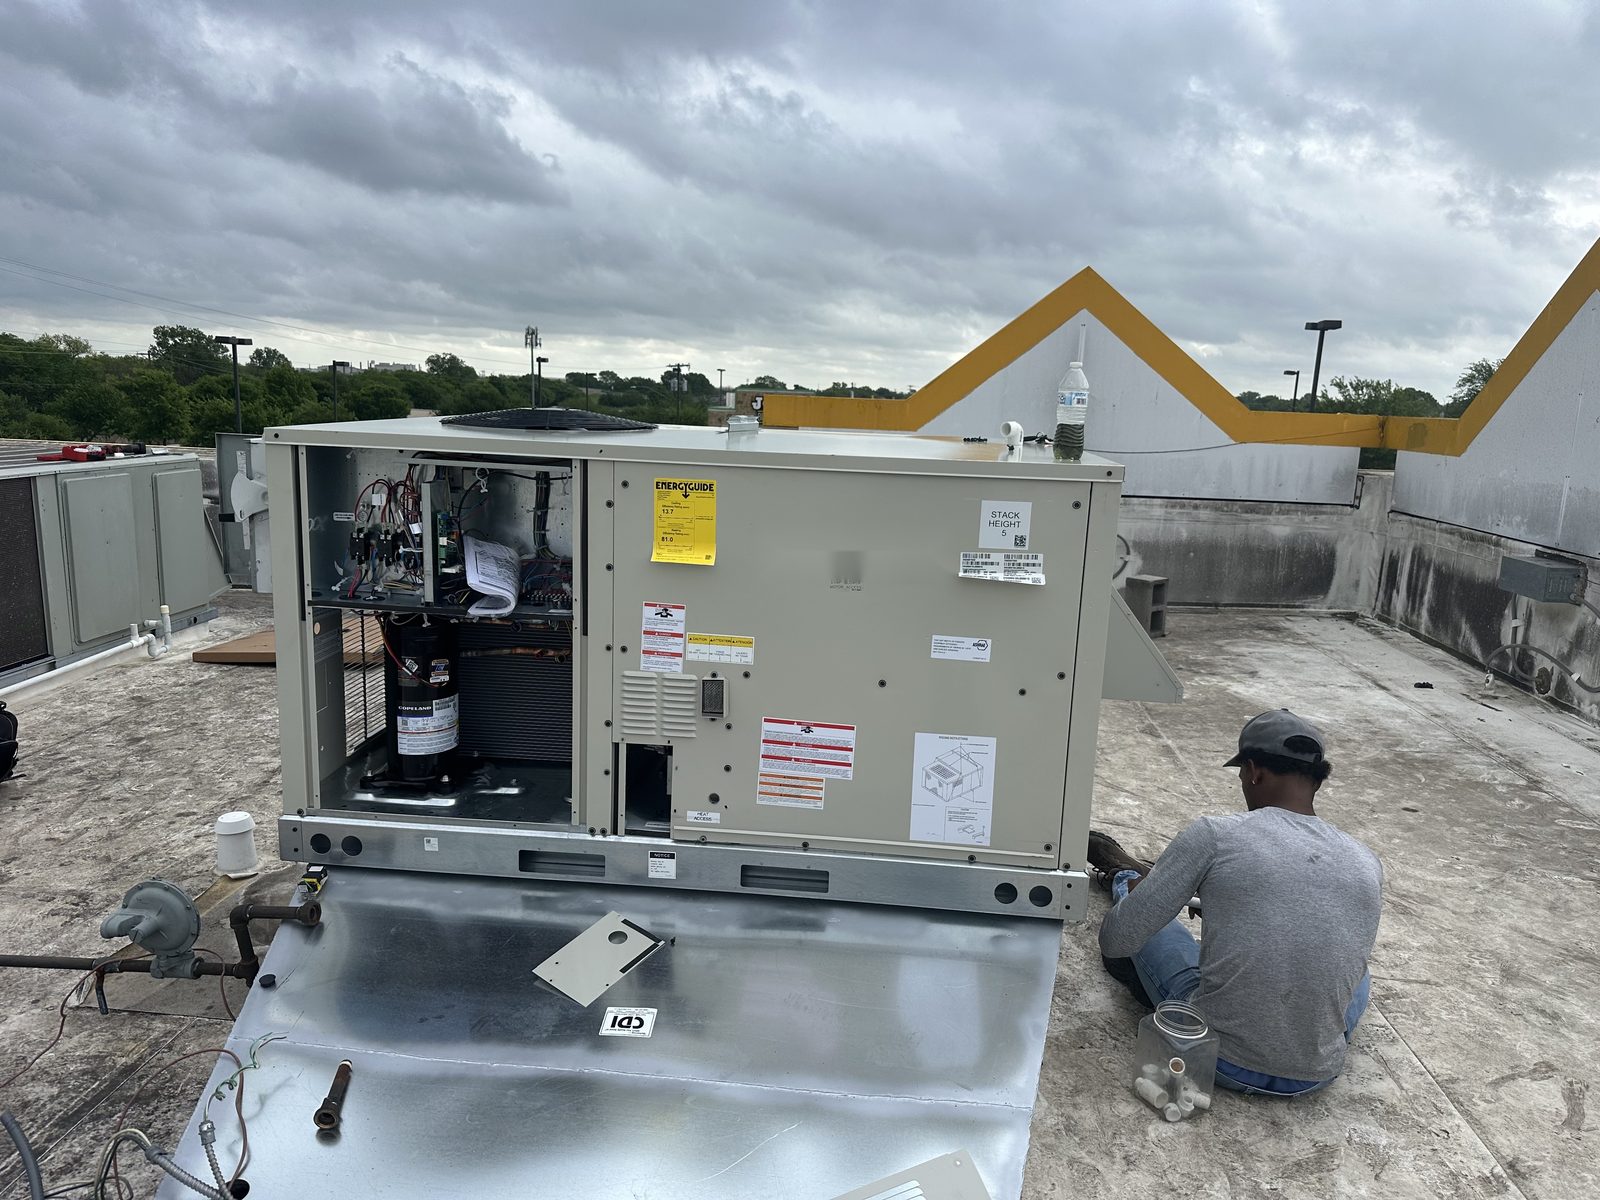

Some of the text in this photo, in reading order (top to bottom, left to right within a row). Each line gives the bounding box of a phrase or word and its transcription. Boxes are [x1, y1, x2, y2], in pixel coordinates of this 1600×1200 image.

[656, 481, 714, 492] ENERGYGUIDE
[991, 511, 1020, 519] STACK
[988, 520, 1021, 528] HEIGHT
[610, 1015, 645, 1029] CDI
